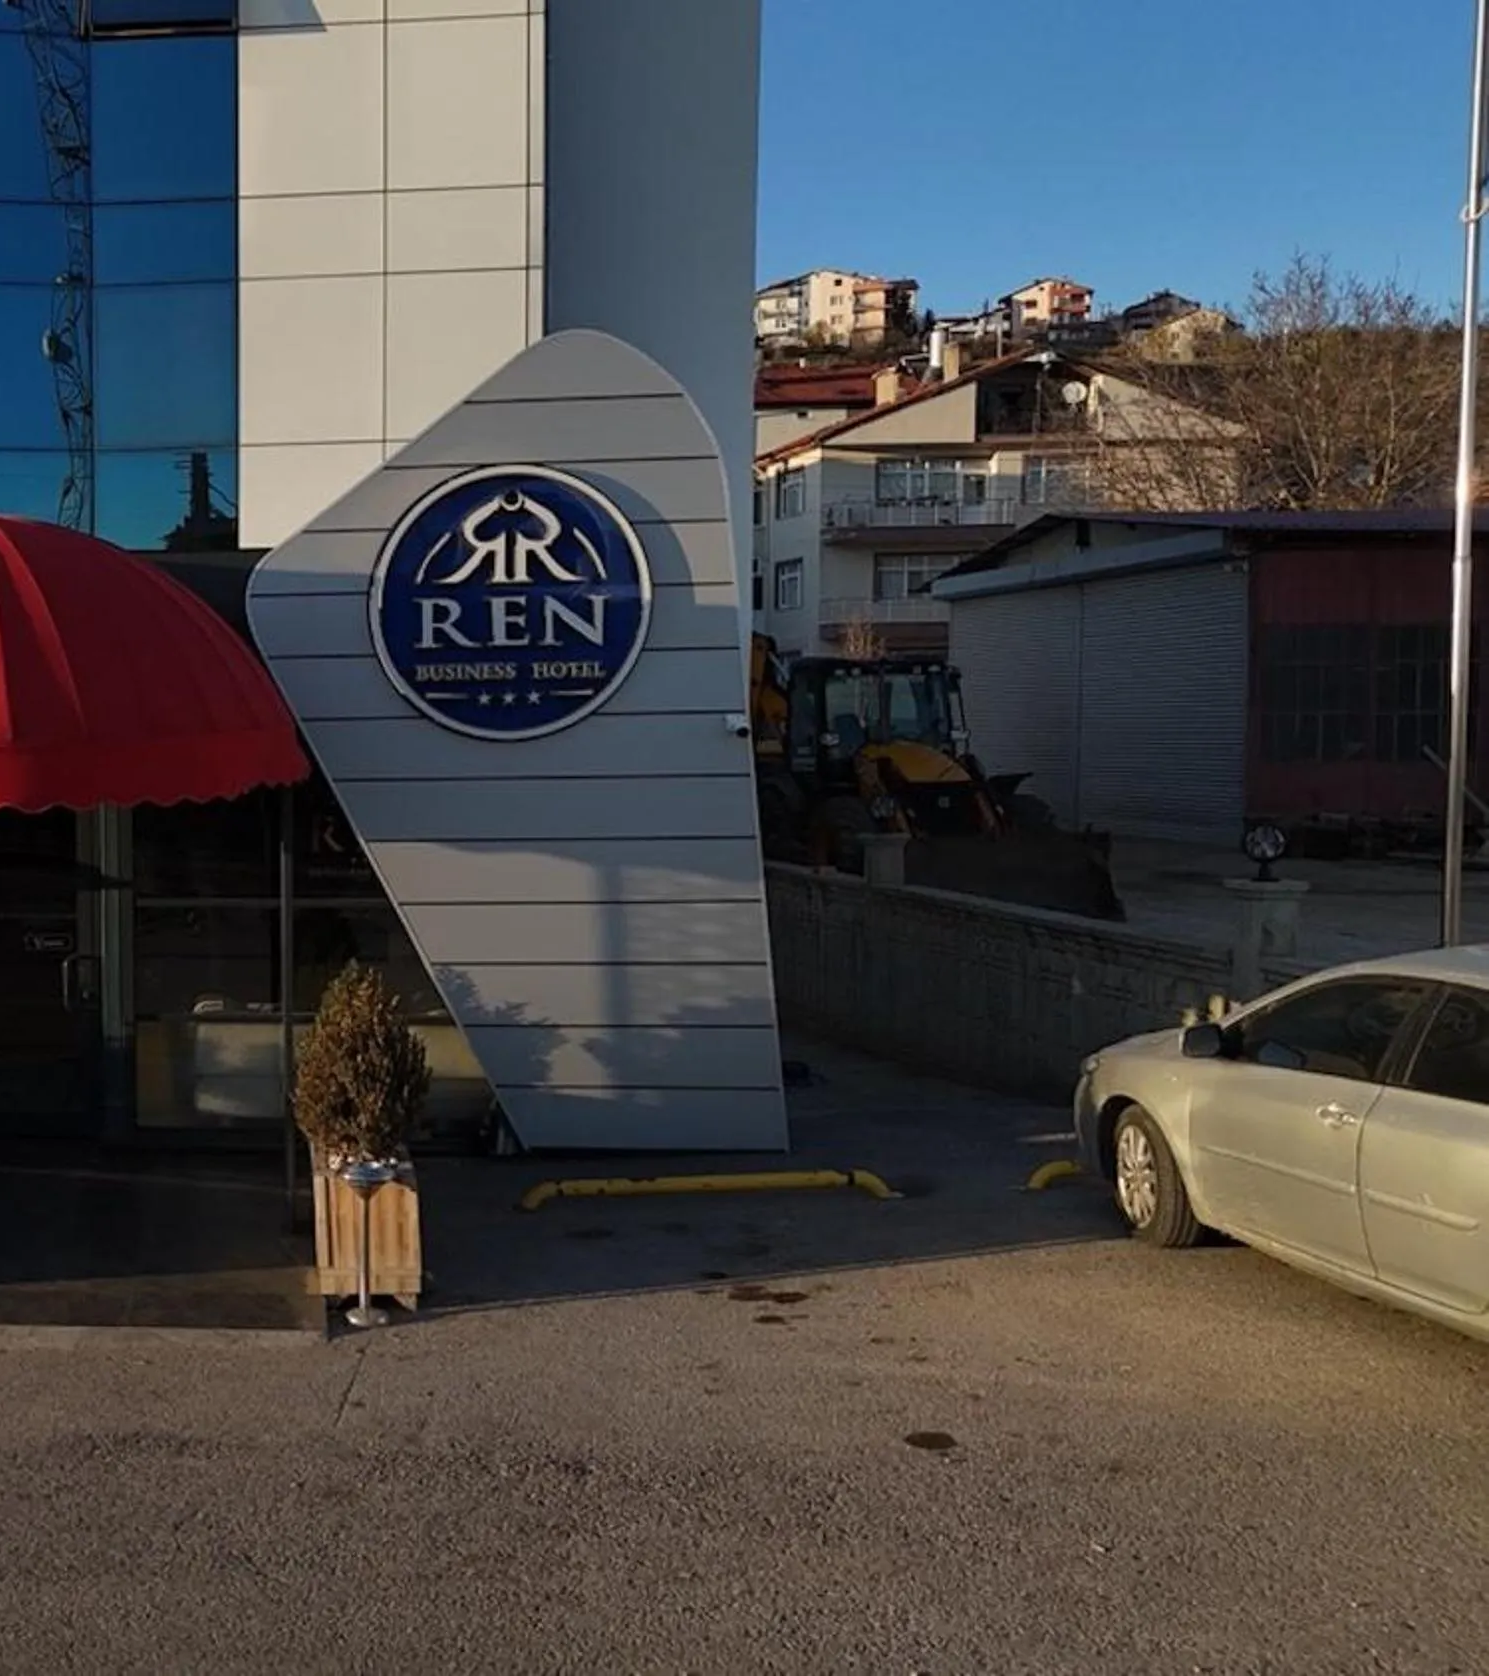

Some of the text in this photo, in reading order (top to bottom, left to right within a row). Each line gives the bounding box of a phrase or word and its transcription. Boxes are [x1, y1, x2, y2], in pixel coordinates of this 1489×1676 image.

[412, 594, 610, 648] REN
[415, 660, 606, 682] BUSINESS HOTEL
